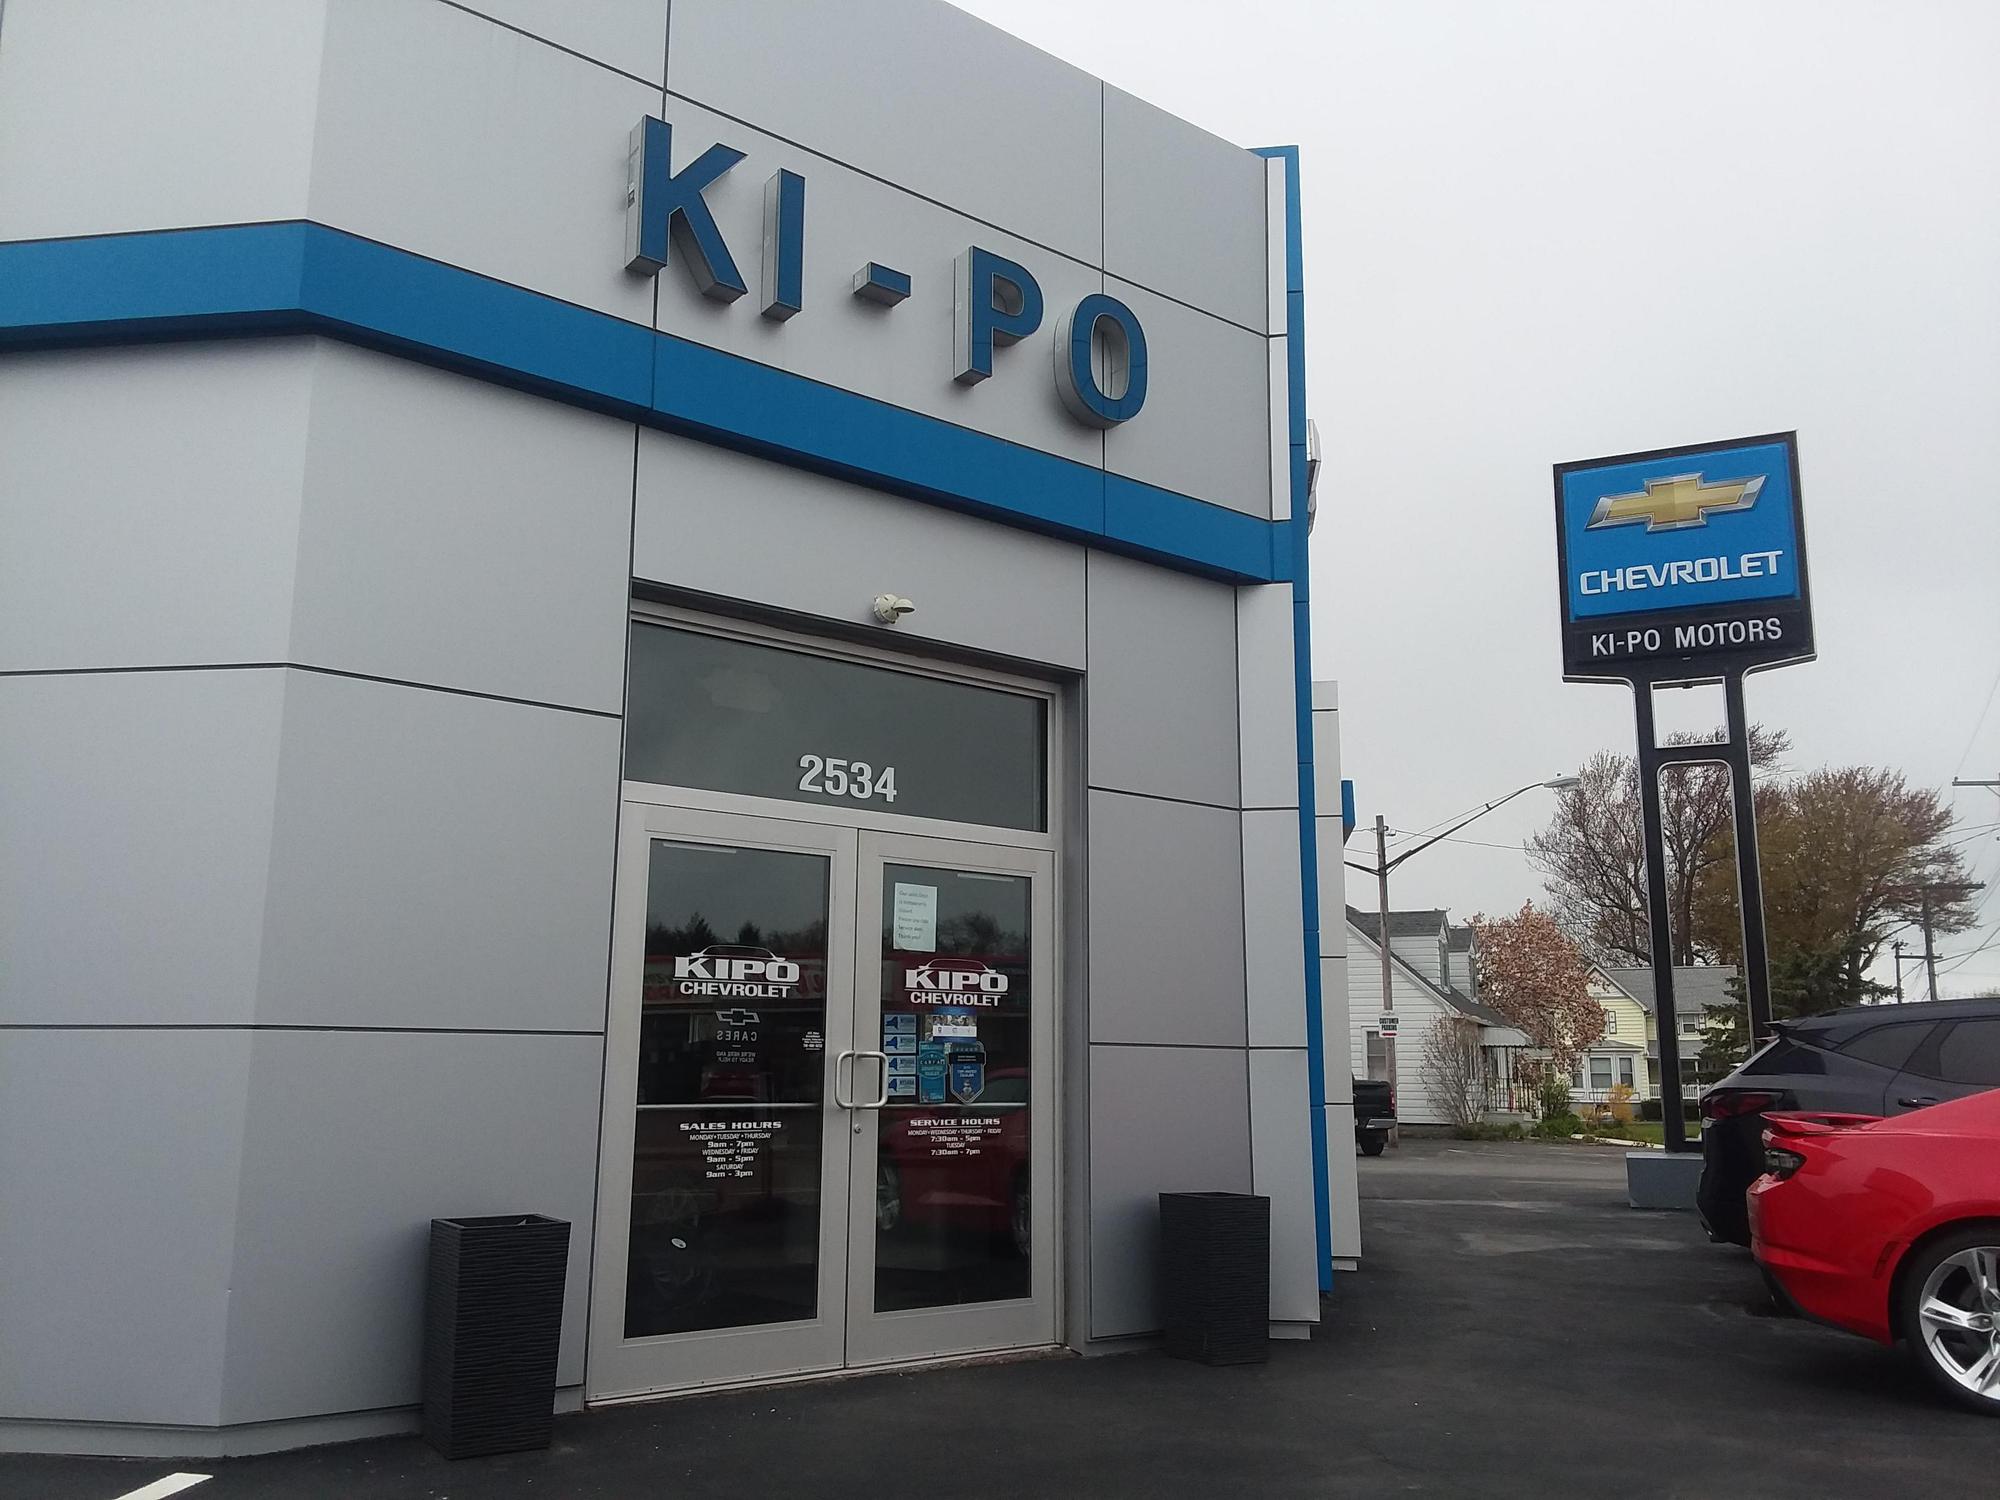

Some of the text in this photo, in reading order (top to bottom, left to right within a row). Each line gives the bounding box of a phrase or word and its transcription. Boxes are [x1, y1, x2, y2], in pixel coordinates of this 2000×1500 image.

[627, 114, 1148, 428] KI-PO
[1579, 550, 1783, 595] CHEVROLET
[1592, 617, 1783, 656] KI-PO MOTORS
[799, 754, 897, 802] 2534
[674, 956, 800, 982] KIPO
[680, 981, 791, 998] CHEVROLET
[905, 969, 1008, 992] KIPO
[910, 991, 1001, 1006] CHEVROLET
[680, 1121, 782, 1130] SALES HOURS
[736, 1140, 754, 1148] 7pm
[735, 1155, 754, 1163] 5pm
[734, 1170, 753, 1178] 3pm
